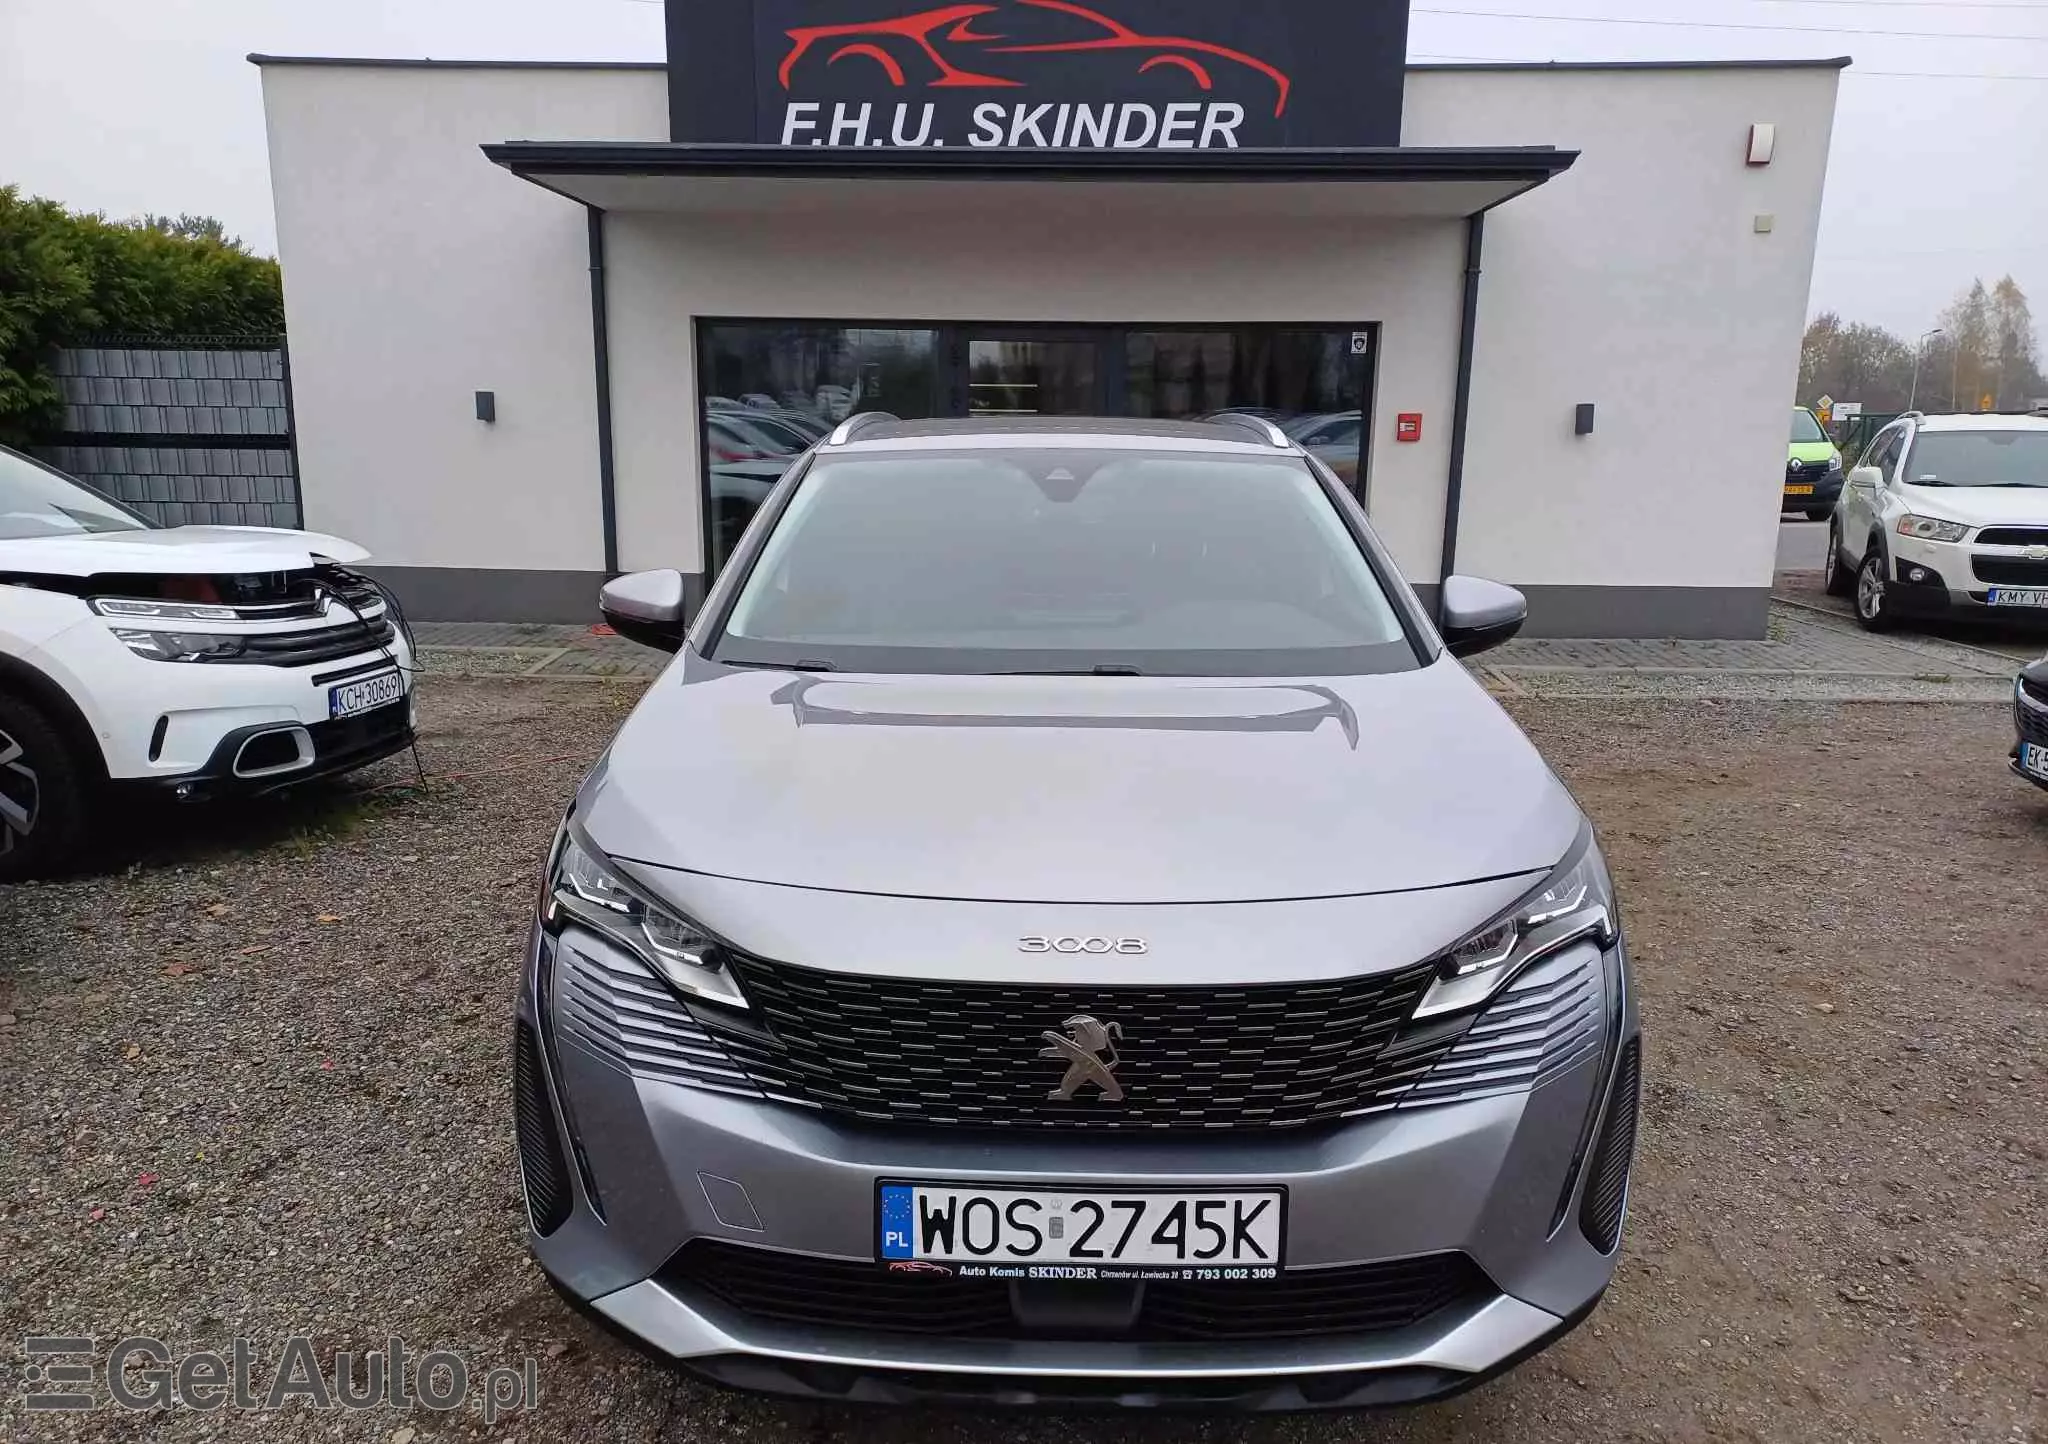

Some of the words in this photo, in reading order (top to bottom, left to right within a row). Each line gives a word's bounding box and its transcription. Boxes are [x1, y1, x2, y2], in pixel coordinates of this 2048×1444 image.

[781, 102, 943, 147] F.H.U.
[967, 102, 1245, 148] SKINDER
[1999, 591, 2027, 603] KMY
[338, 685, 363, 712] KCH
[365, 675, 397, 704] 30869
[1018, 936, 1148, 955] 3008
[919, 1195, 1043, 1257] WOS
[1069, 1199, 1272, 1259] 2745K
[885, 1231, 909, 1248] PL
[959, 1265, 986, 1276] Auto
[989, 1266, 1025, 1277] Komis
[1028, 1266, 1098, 1279] SKINDER
[1196, 1269, 1220, 1280] 793
[1224, 1268, 1248, 1280] 002
[1252, 1267, 1277, 1279] 309
